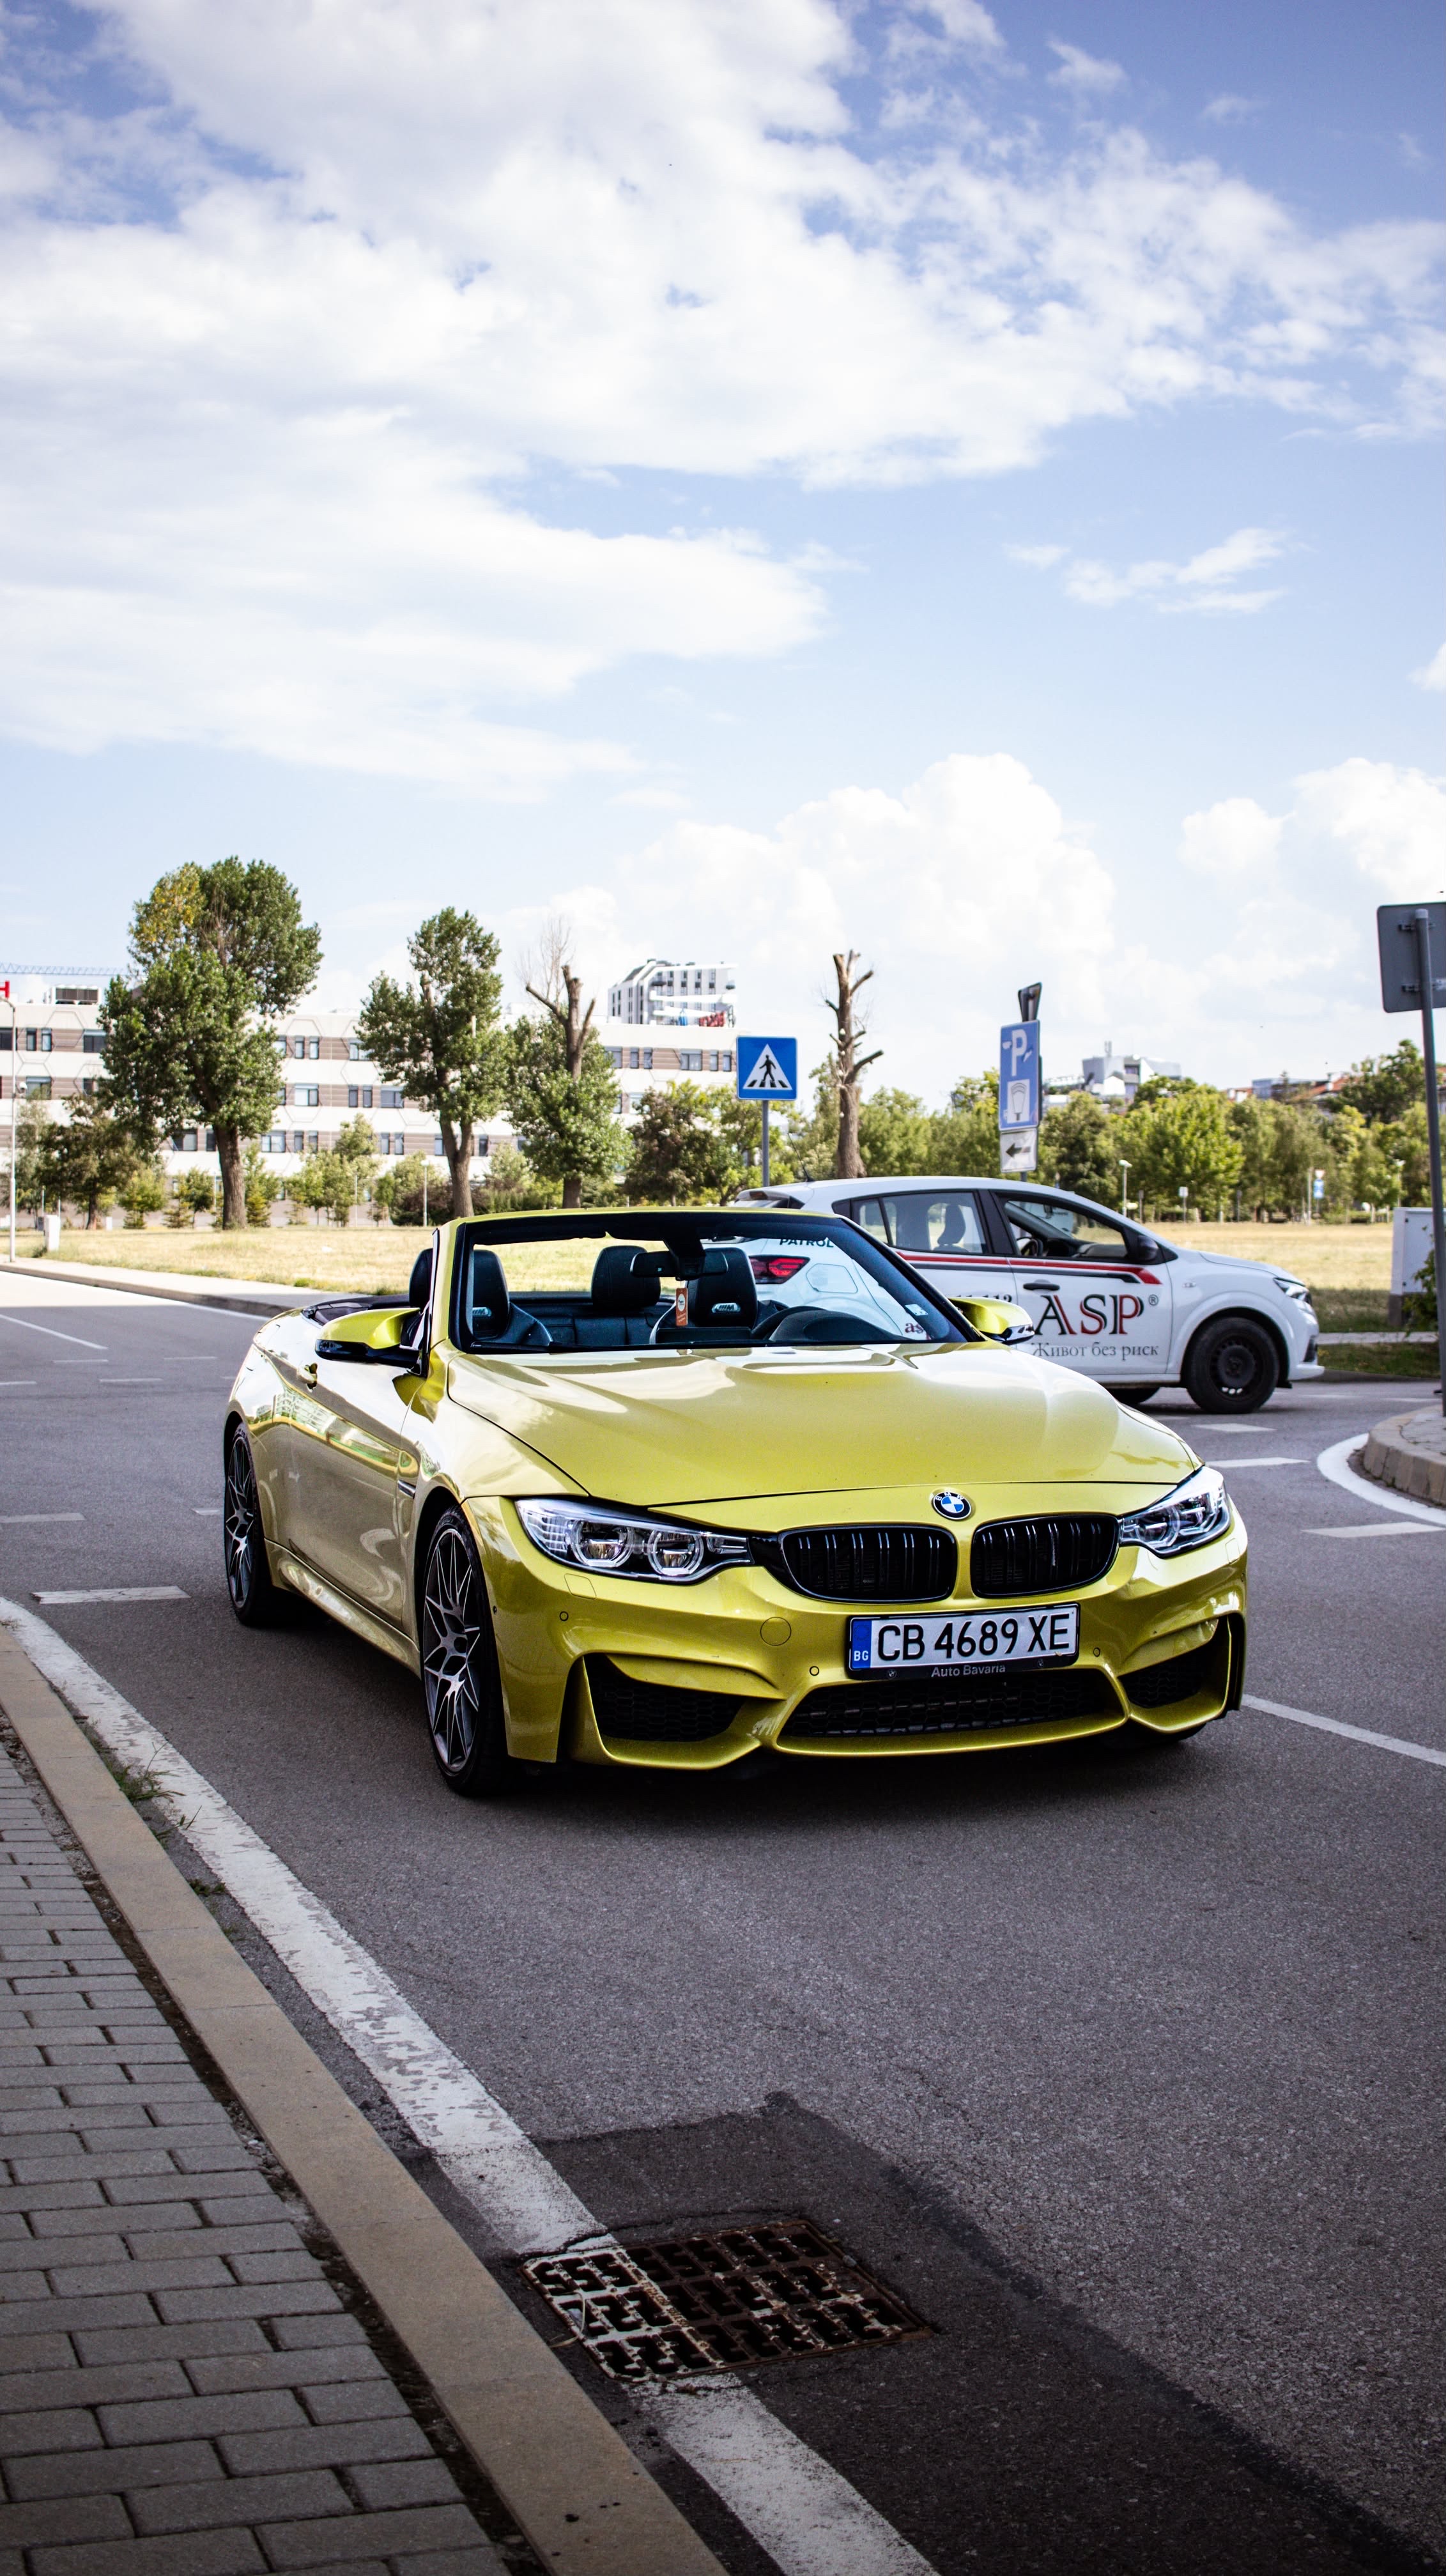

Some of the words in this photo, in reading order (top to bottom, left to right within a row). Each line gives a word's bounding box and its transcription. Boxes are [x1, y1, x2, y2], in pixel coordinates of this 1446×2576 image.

[1011, 1030, 1027, 1077] P
[1034, 1294, 1144, 1335] ASP
[1031, 1342, 1087, 1357] Живот
[1091, 1341, 1116, 1355] без
[1122, 1345, 1160, 1361] риск
[935, 1492, 964, 1501] BMW
[878, 1624, 925, 1661] CB
[934, 1618, 1019, 1658] 4689
[1027, 1614, 1070, 1653] XE
[854, 1651, 868, 1662] BG
[931, 1667, 960, 1677] Auto
[963, 1664, 1006, 1675] Bavaria
